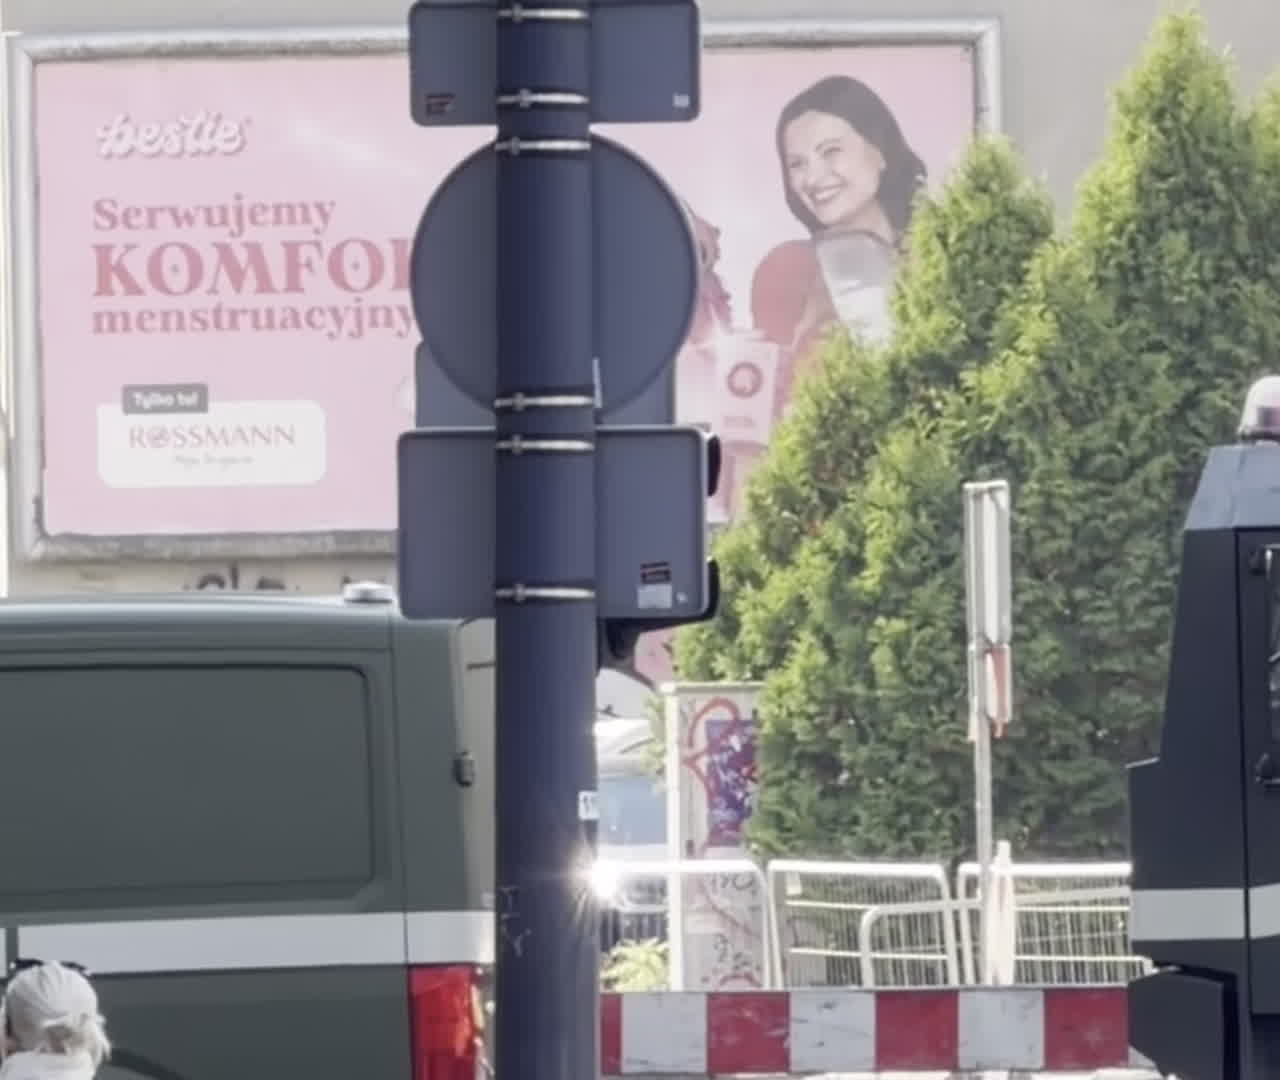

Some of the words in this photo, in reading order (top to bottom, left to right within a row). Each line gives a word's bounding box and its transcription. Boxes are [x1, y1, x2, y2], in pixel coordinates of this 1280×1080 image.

[96, 110, 248, 159] bestie
[92, 193, 337, 238] Serwujemy
[92, 297, 413, 340] menstruacyjny
[128, 423, 296, 449] ROSSMANN
